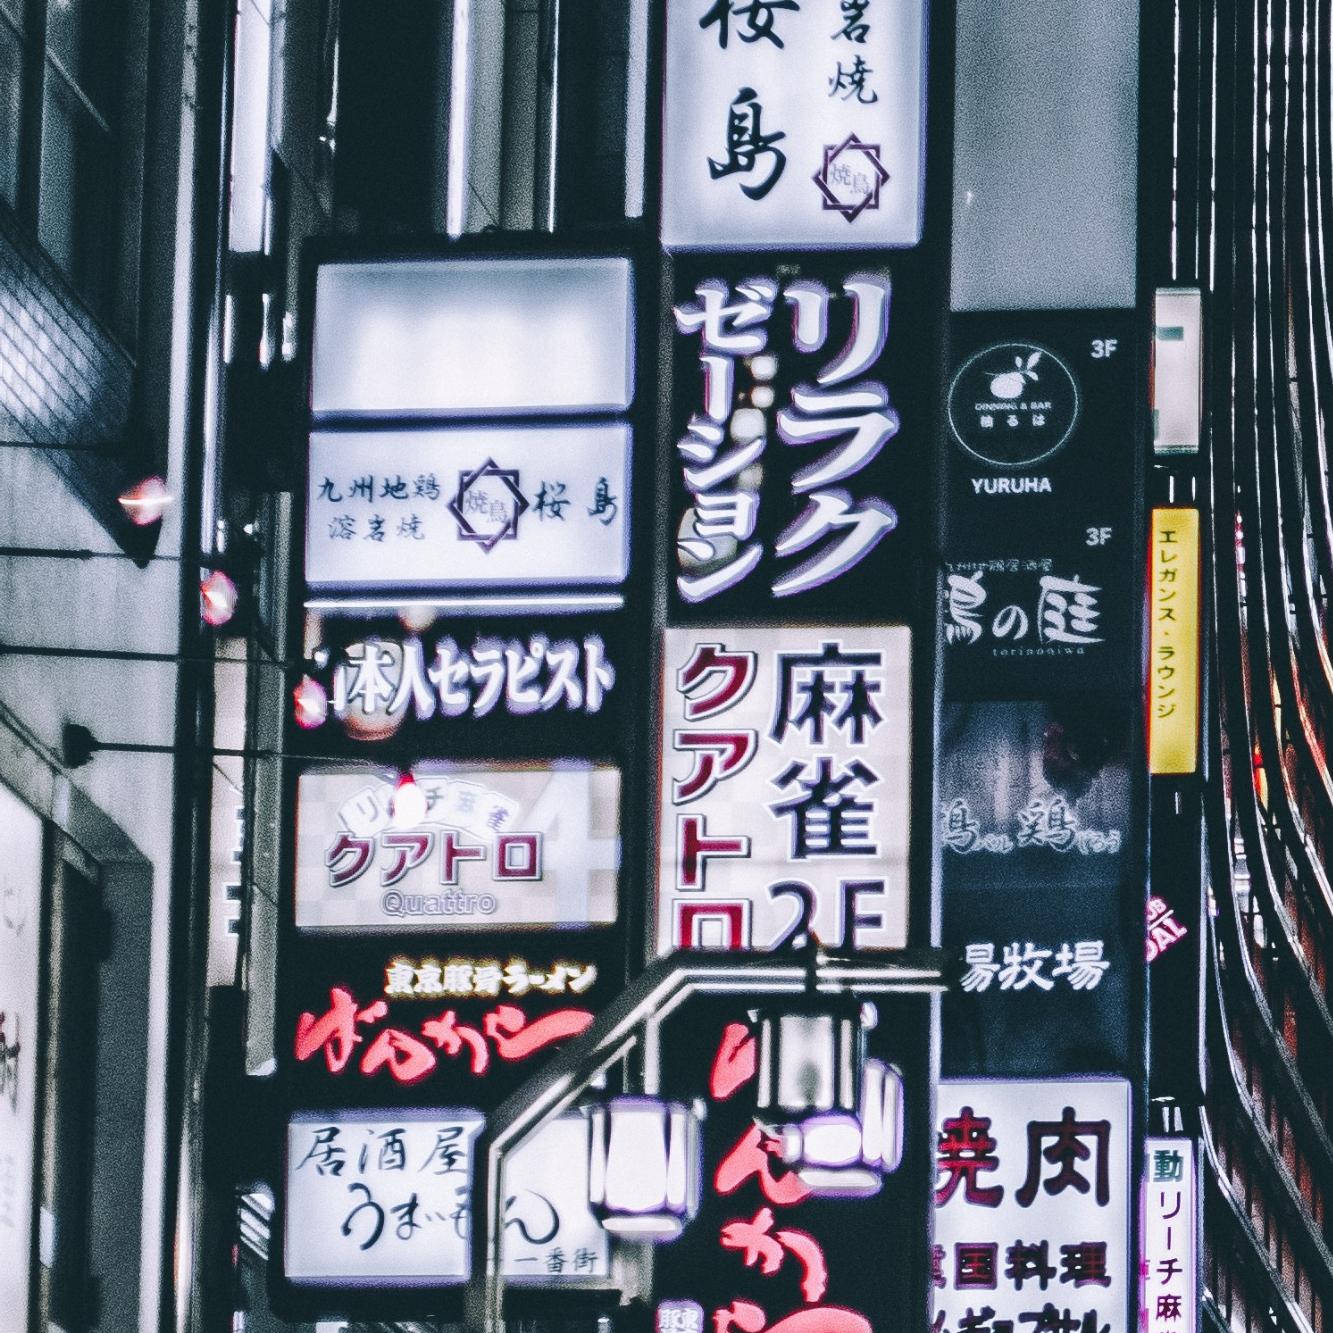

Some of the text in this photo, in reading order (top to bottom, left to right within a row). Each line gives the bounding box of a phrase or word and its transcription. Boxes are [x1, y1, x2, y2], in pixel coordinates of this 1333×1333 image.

[1091, 340, 1118, 358] 3F
[317, 474, 441, 503] 九州地鶏
[532, 477, 619, 528] 桜島
[971, 478, 1052, 494] YURUHA
[1086, 527, 1113, 546] 3F
[768, 641, 884, 860] 麻雀
[674, 643, 757, 948] クアトロ
[326, 830, 542, 887] クアトロ
[382, 890, 498, 915] Quattro
[768, 878, 884, 948] 2F
[296, 1127, 472, 1177] 居酒屋
